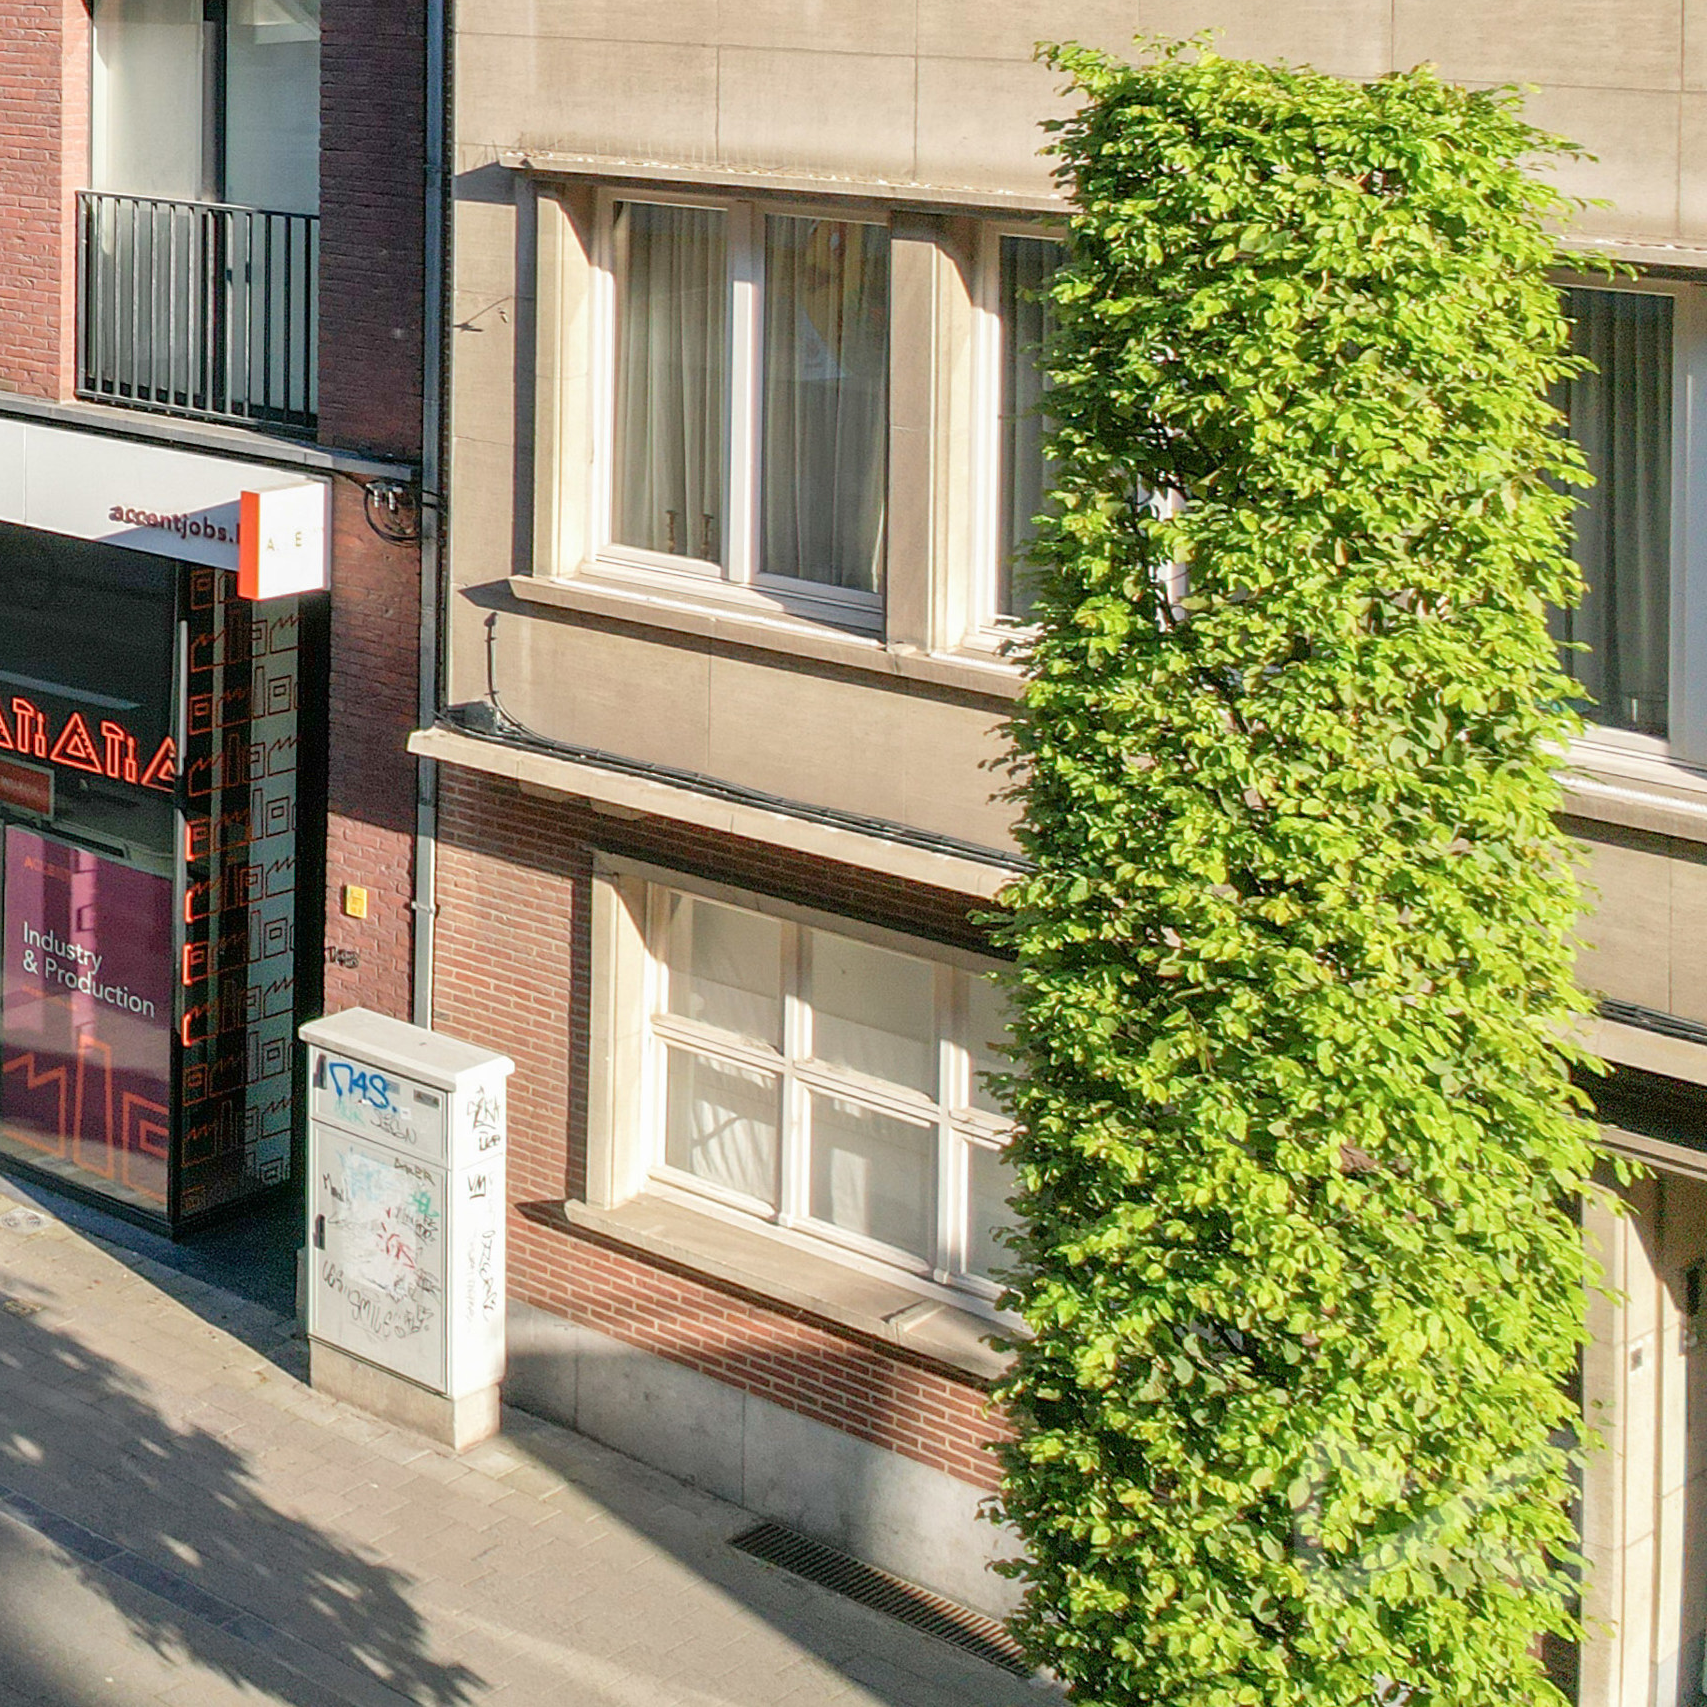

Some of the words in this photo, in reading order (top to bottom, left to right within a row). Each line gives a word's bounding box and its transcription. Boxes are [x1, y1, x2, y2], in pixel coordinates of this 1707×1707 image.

[23, 920, 103, 975] Industry
[23, 949, 38, 976] &
[45, 958, 155, 1019] Production
